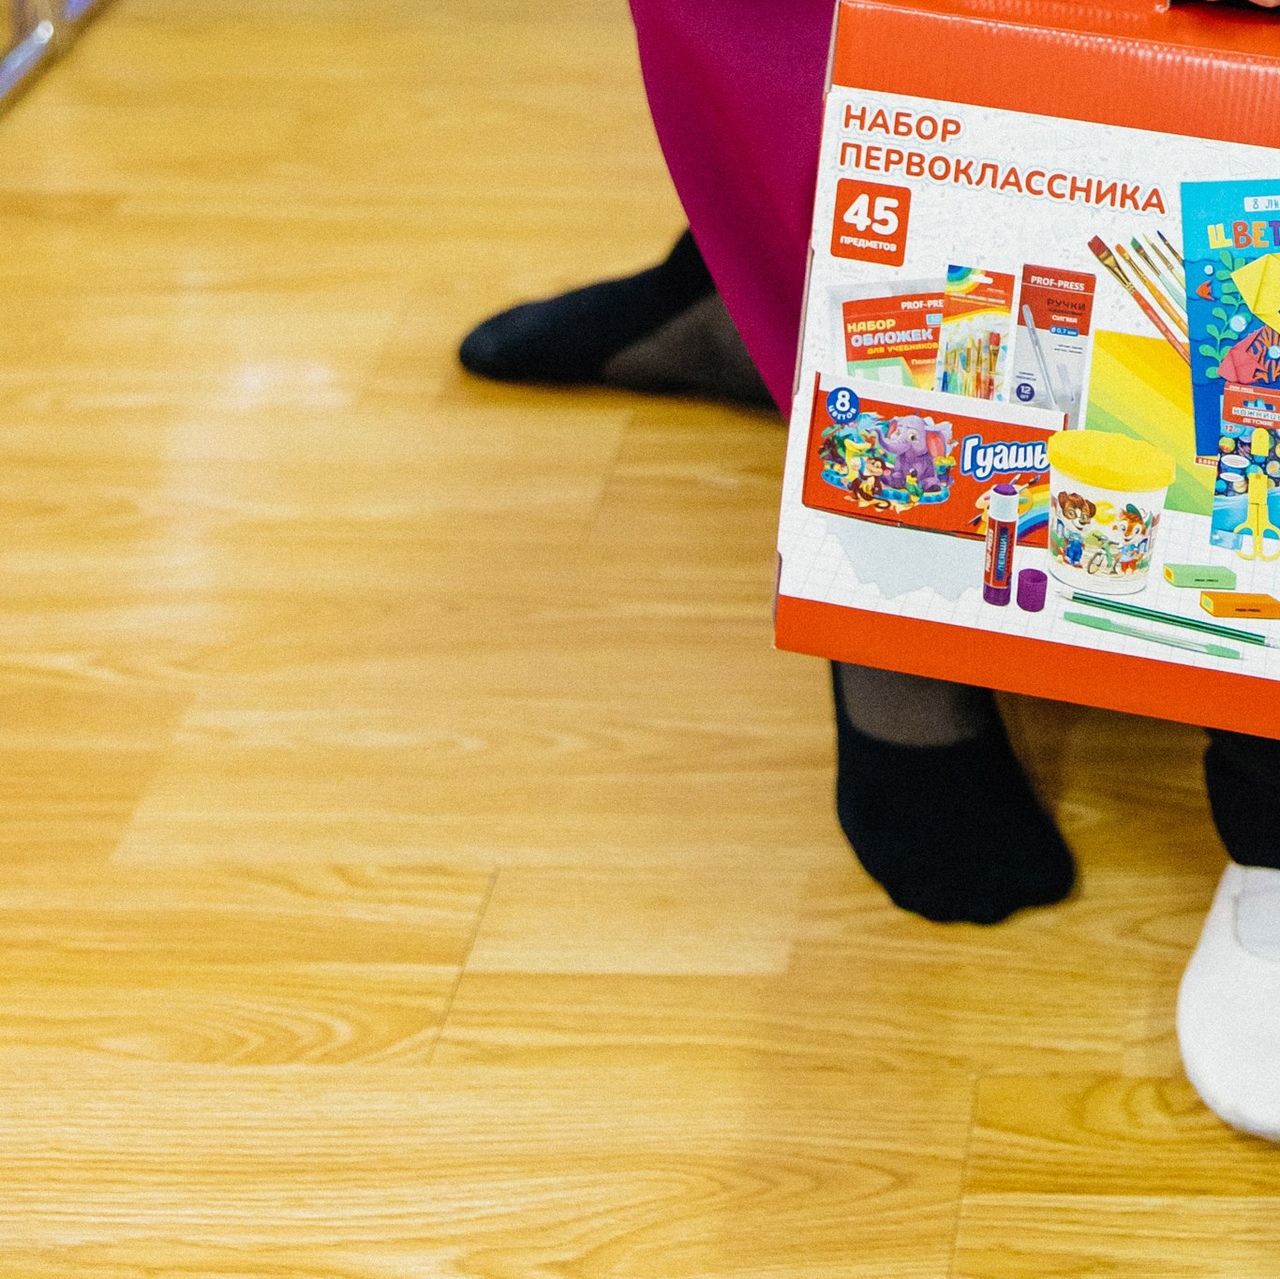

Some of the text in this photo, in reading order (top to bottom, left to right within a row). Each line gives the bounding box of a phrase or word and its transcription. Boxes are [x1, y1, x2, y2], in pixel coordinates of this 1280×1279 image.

[843, 104, 962, 142] НАБОР
[839, 142, 1166, 214] ПЕРВОКЛАССНИКА
[1252, 198, 1259, 209] 8
[843, 193, 900, 236] 45
[839, 235, 897, 252] ПРЕДМЕТОВ
[1030, 275, 1085, 291] PROF-PRESS
[1047, 298, 1086, 310] РУЧКИ
[847, 319, 896, 333] НАБОР
[851, 328, 933, 348] ОБЛОЖЕК
[1020, 386, 1031, 394] 12
[835, 390, 851, 411] 8
[828, 405, 857, 420] ЦВЕТОВ
[963, 436, 1049, 478] Гуашь
